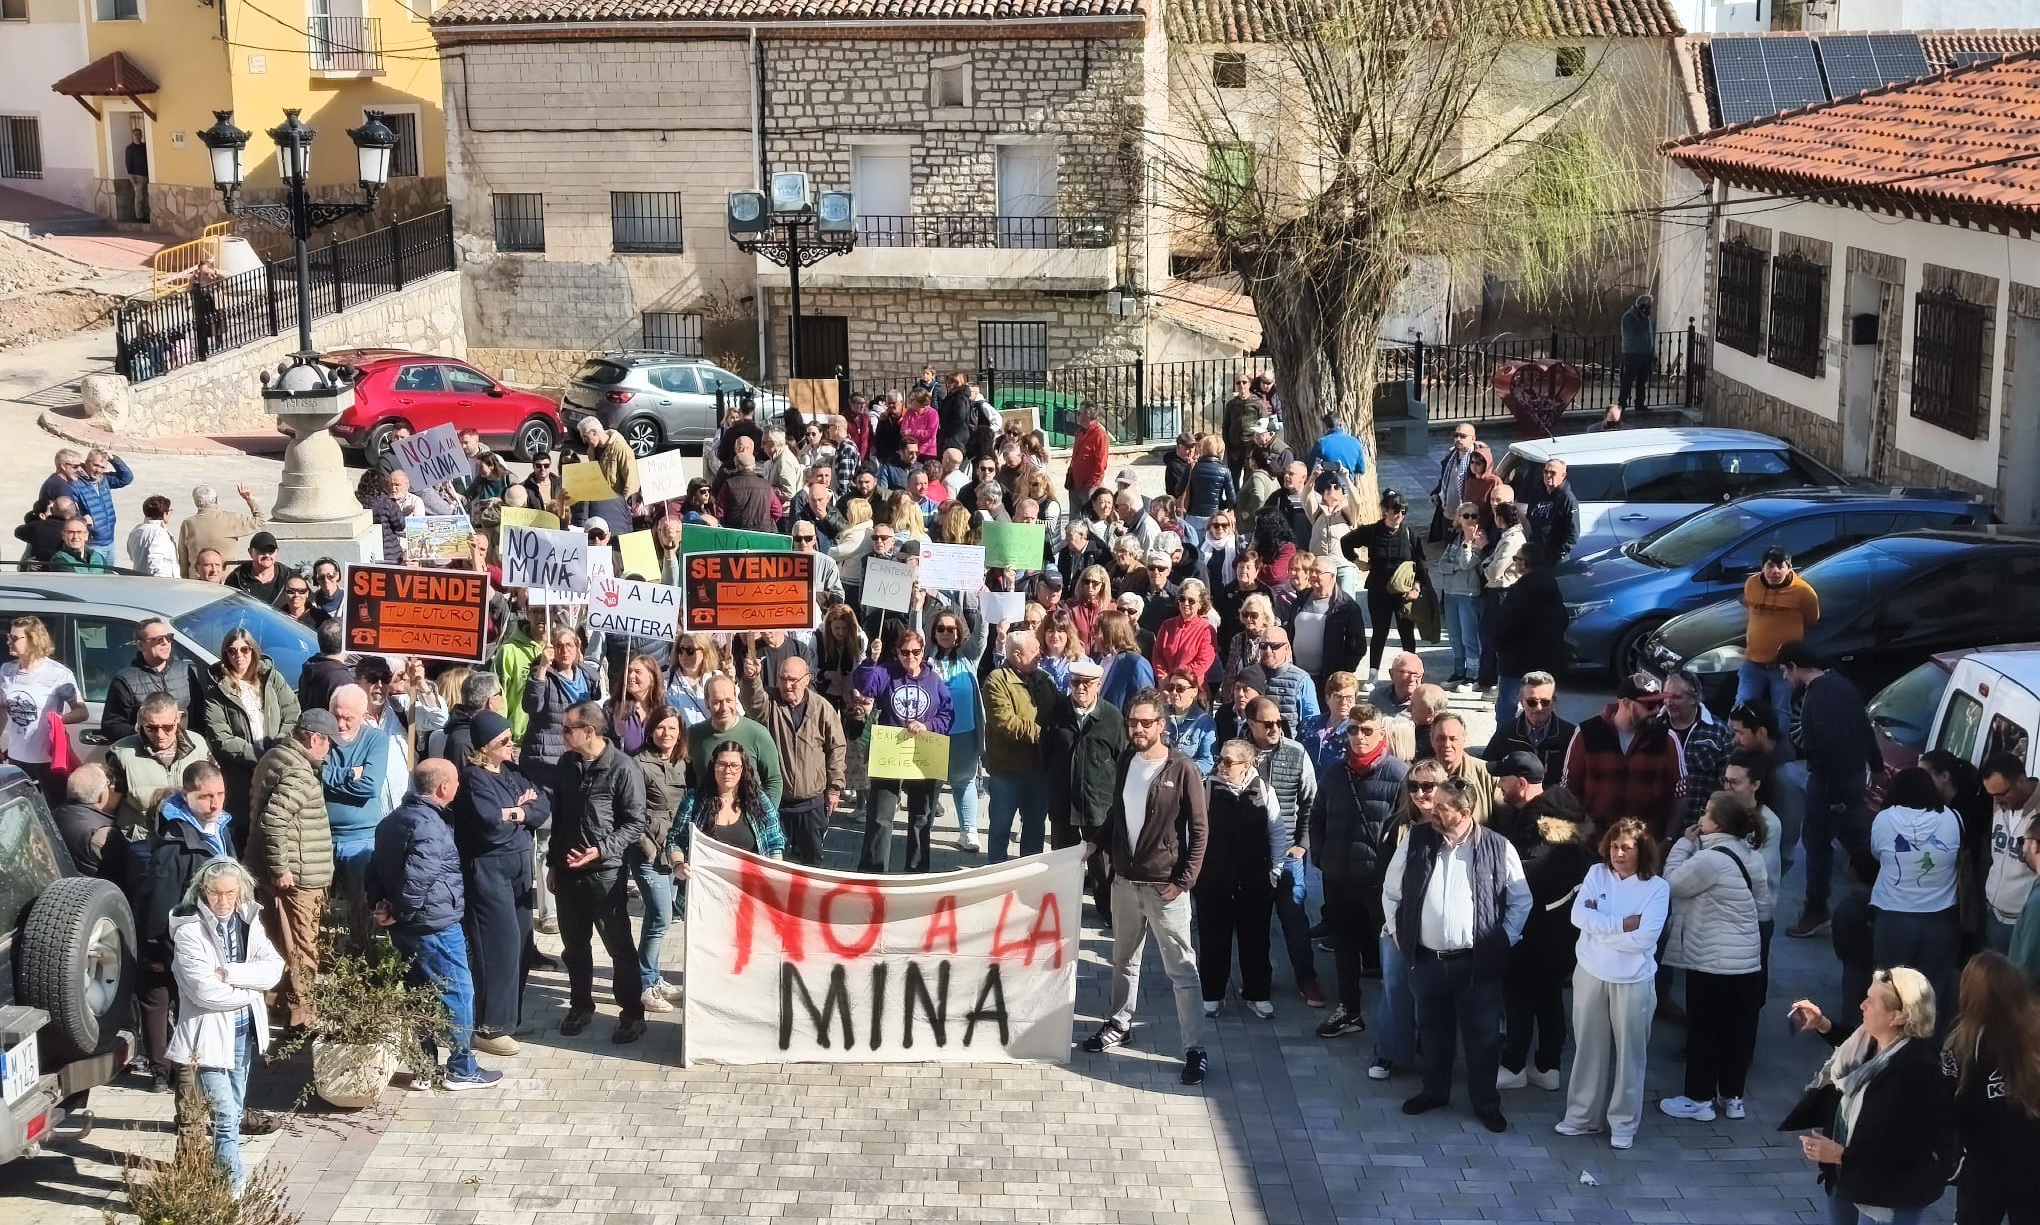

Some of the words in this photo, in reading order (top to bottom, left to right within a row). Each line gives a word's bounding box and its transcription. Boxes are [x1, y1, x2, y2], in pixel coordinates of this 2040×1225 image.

[400, 436, 432, 468] NO
[439, 441, 446, 454] A
[446, 437, 456, 450] LA
[420, 453, 460, 486] MINA
[652, 476, 672, 490] NO
[508, 528, 539, 560] NO
[546, 547, 557, 562] A
[562, 547, 580, 562] LA
[509, 557, 575, 588] MINA
[691, 558, 722, 579] SE
[728, 556, 808, 579] VENDE
[869, 562, 914, 578] CANTERA
[353, 571, 386, 598] SE
[394, 574, 480, 604] VENDE
[628, 584, 642, 601] A
[651, 587, 674, 606] LA
[721, 585, 746, 597] TU
[752, 584, 798, 598] AGUA
[876, 582, 900, 596] NO
[385, 605, 406, 617] TU
[413, 606, 474, 622] FUTURO
[742, 606, 806, 620] CANTERA
[589, 612, 674, 640] CANTERA
[401, 631, 472, 648] CANTERA
[731, 856, 886, 974] NO
[923, 894, 958, 954] A
[990, 892, 1063, 969] LA
[779, 959, 1010, 1050] MINA
